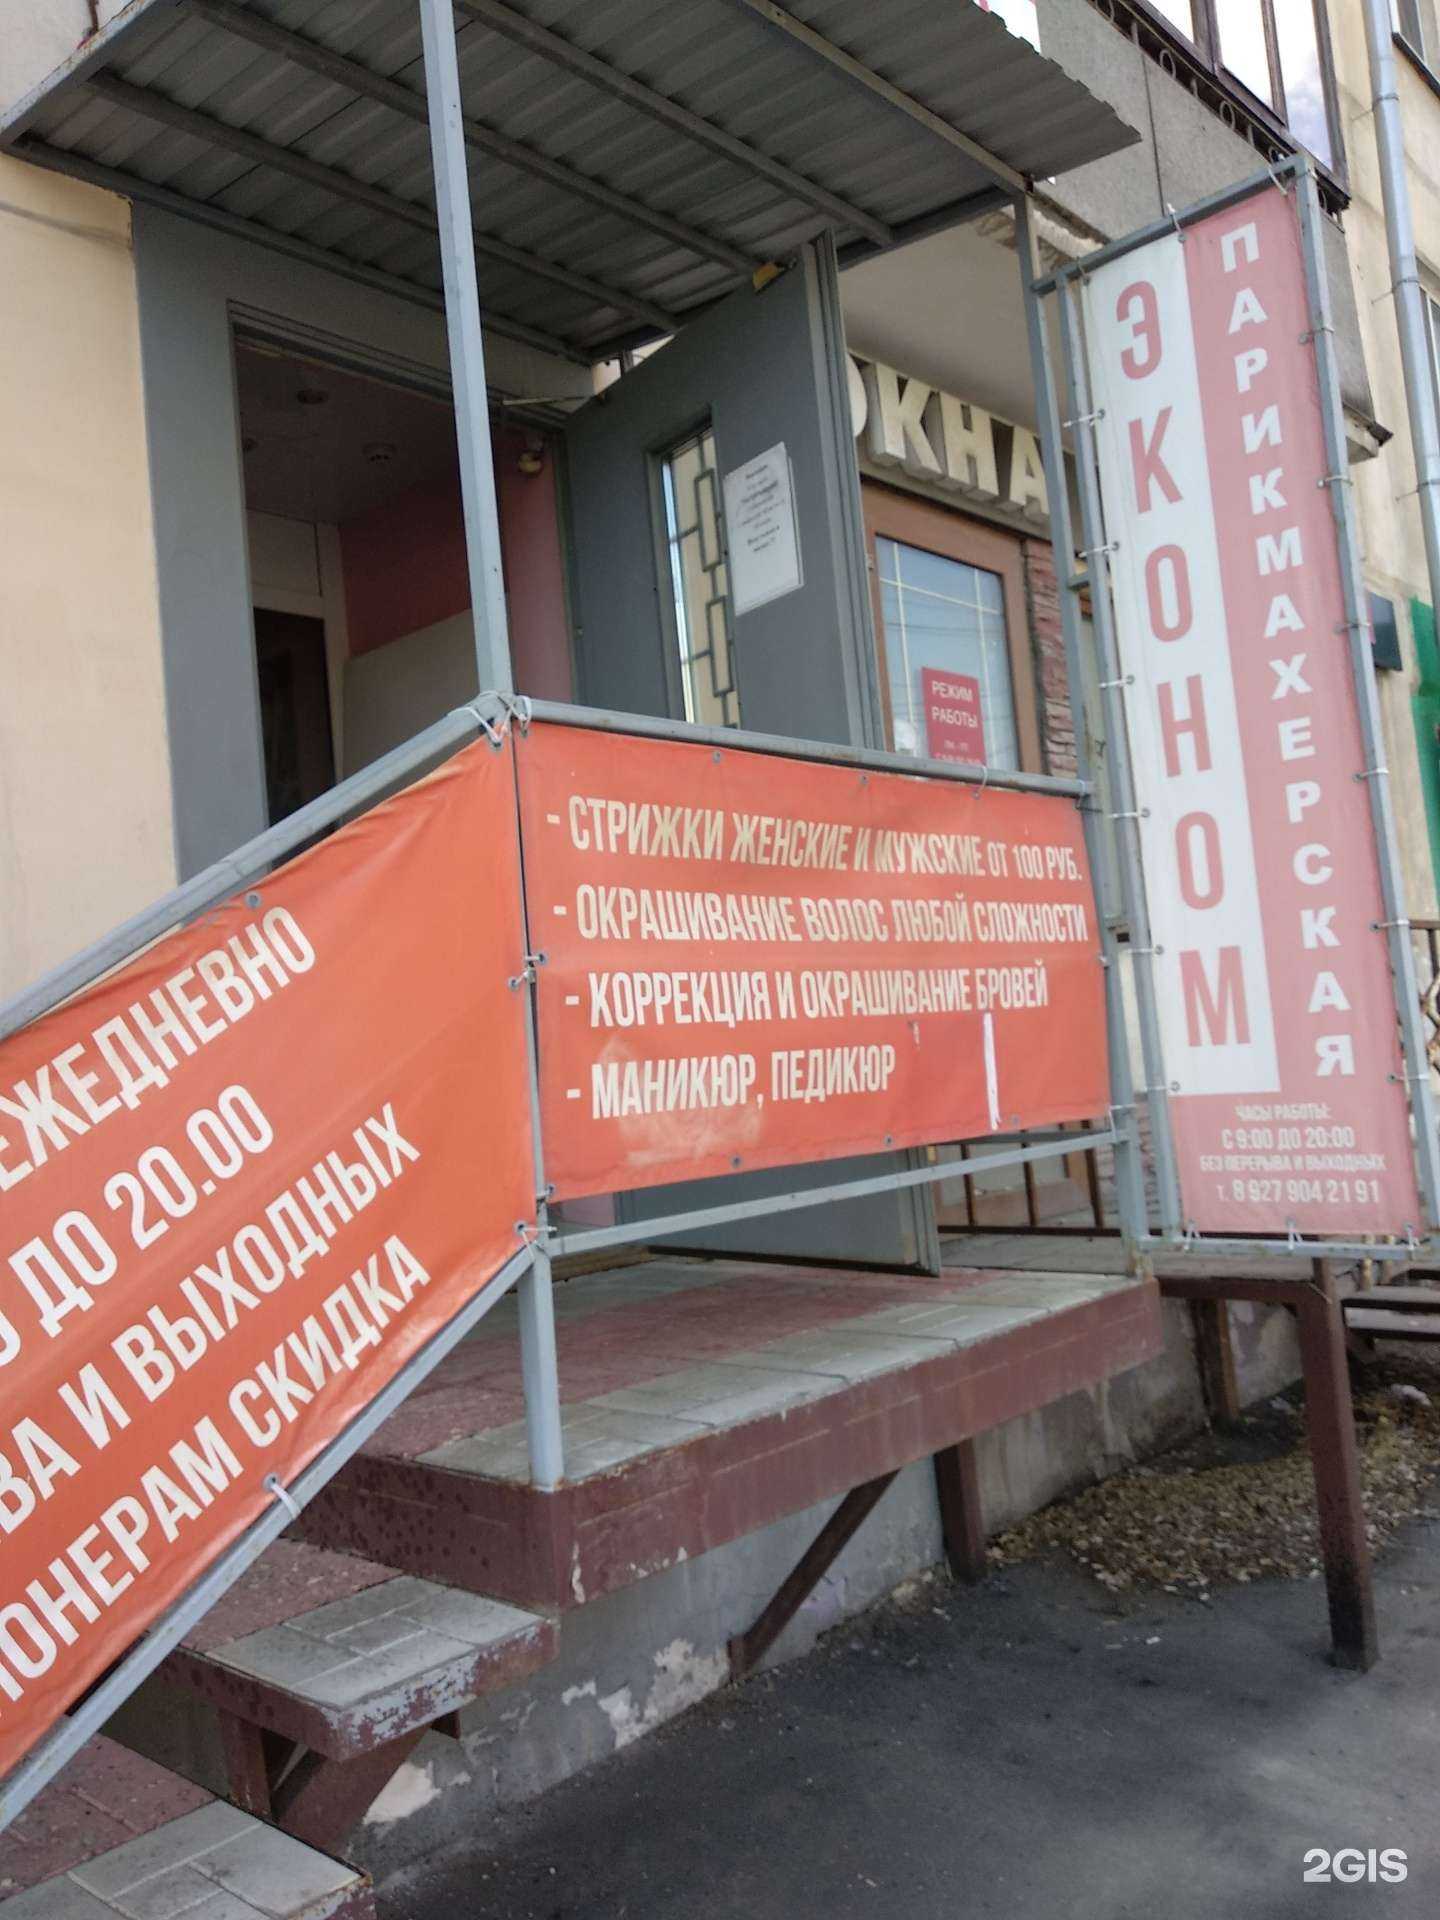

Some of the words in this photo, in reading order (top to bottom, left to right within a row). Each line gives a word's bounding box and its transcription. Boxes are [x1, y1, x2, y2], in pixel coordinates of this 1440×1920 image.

[1115, 280, 1252, 1048] ЭКОНОМ
[1220, 221, 1356, 1078] ПАРИКМАХЕРСКАЯ
[931, 680, 974, 703] РЕЖИМ
[931, 706, 979, 728] РАБОТЫ
[568, 795, 724, 861] СТРИЖКИ
[730, 812, 853, 872] ЖЕНСКИЕ
[854, 827, 870, 872] И
[874, 829, 986, 877] МУЖСКИЕ
[987, 841, 1008, 877] ОТ
[1012, 843, 1044, 881] 100
[1045, 846, 1082, 881] РУБ.
[576, 884, 802, 942] ОКРАШИВАНИЕ
[800, 896, 889, 943] ВОЛОС
[891, 893, 973, 943] ЛЮБОЙ
[973, 901, 1089, 943] СЛОЖНОСТИ
[588, 971, 772, 1028] КОРРЕКЦИЯ
[775, 970, 797, 1020] И
[799, 967, 972, 1020] ОКРАШИВАНИЕ
[975, 959, 1049, 1011] БРОВЕЙ
[591, 1053, 764, 1120] МАНИКЮР,
[771, 1044, 896, 1104] ПЕДИКЮР
[1221, 1128, 1234, 1150] С
[1278, 1127, 1301, 1151] ДО
[1305, 1126, 1356, 1148] 20:00
[7, 1210, 119, 1339] ДО
[103, 1084, 274, 1251] 20.00
[1232, 1179, 1245, 1202] 8
[1249, 1179, 1282, 1203] 927
[1286, 1179, 1322, 1203] 904
[1326, 1180, 1351, 1203] 21
[1354, 1179, 1380, 1203] 91
[57, 1362, 132, 1450] И
[110, 1101, 422, 1403] ВЫХОДНЫХ
[0, 1415, 245, 1702] ОНЕРАМ
[227, 1234, 432, 1448] СКИДКА
